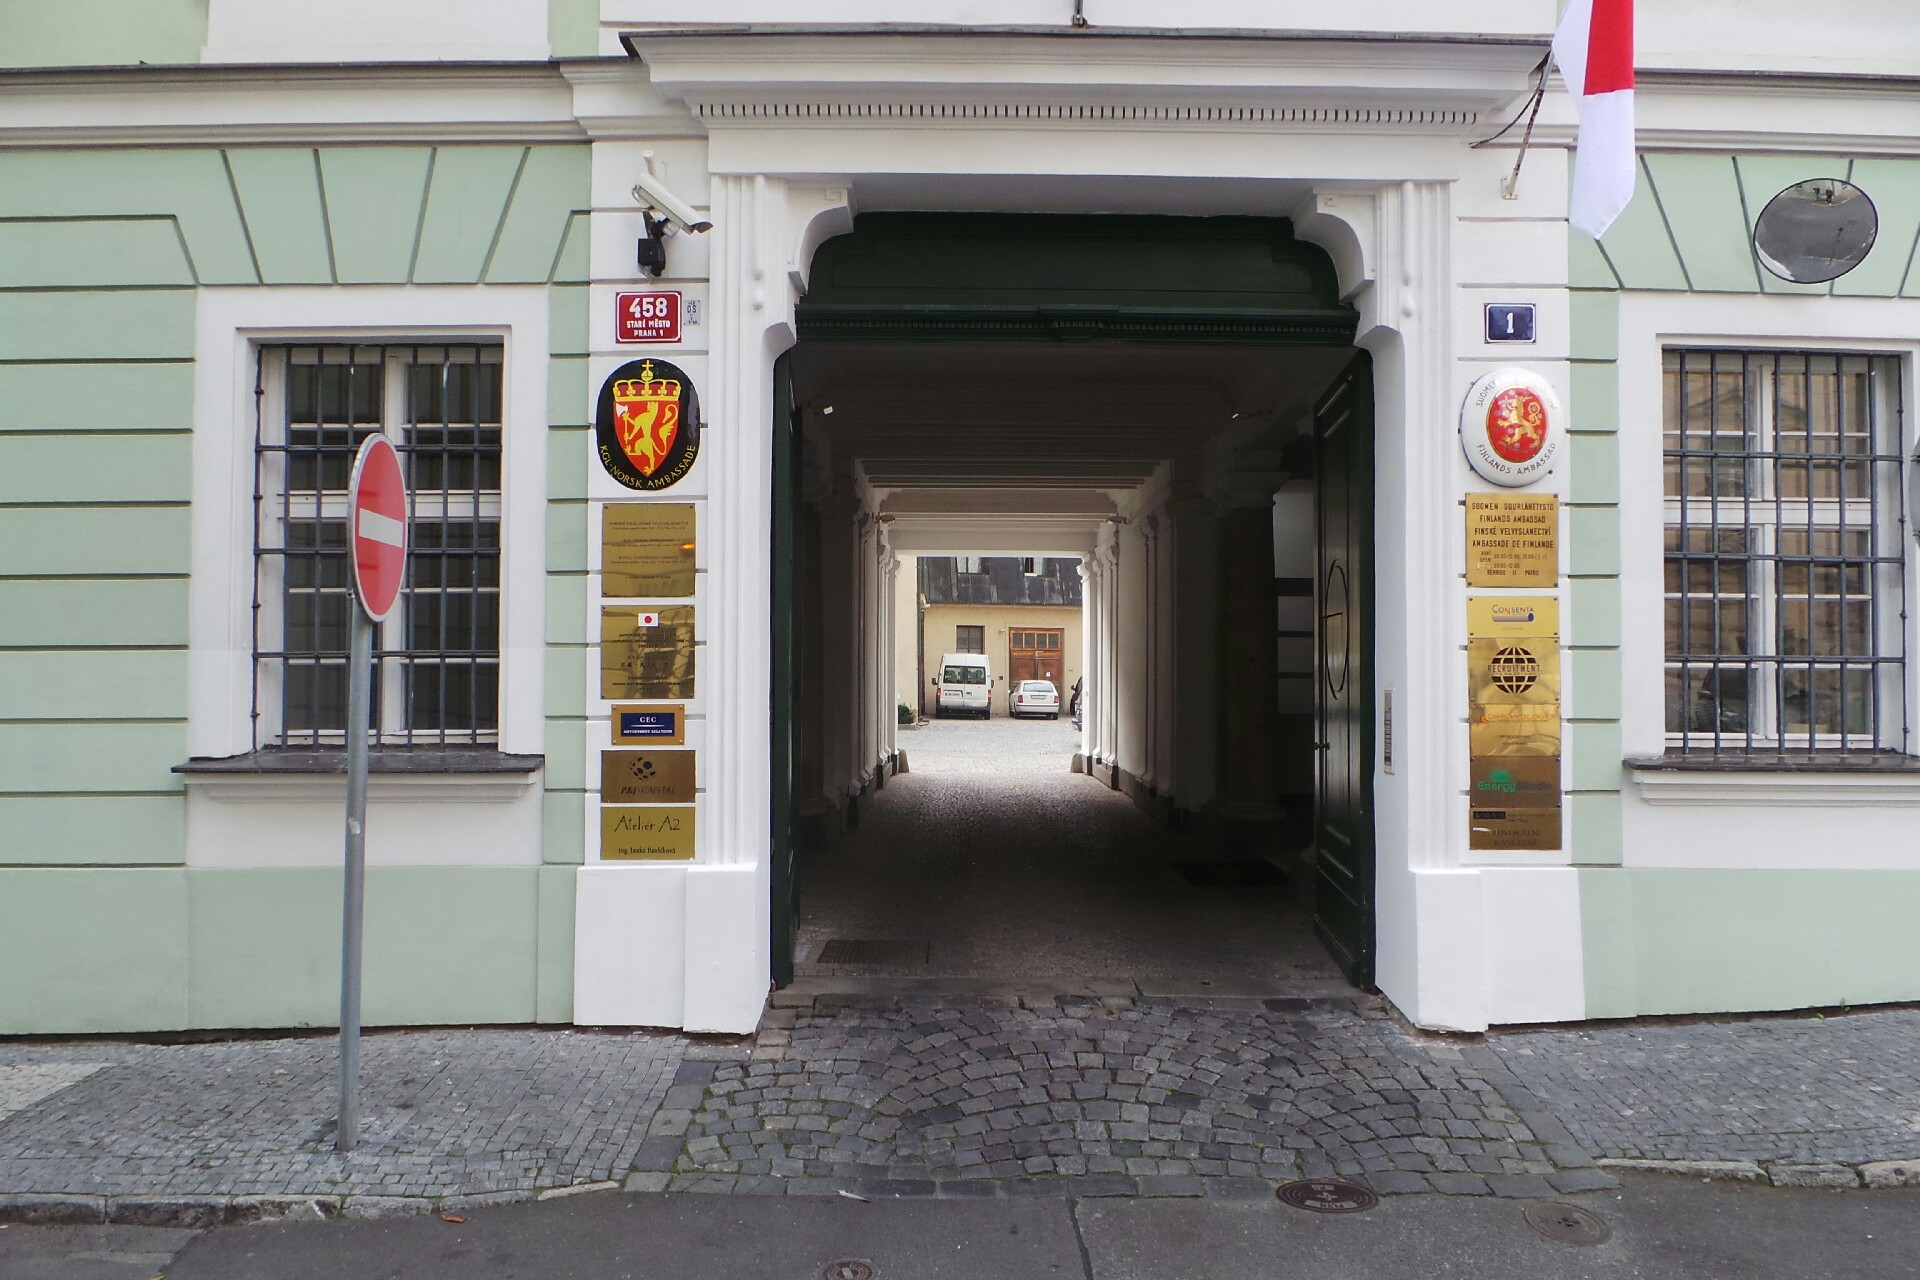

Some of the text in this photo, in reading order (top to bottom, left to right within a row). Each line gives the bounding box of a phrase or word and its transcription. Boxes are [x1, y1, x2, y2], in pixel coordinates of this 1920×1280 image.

[629, 298, 668, 318] 458
[648, 318, 671, 328] MĚSTO
[1506, 312, 1514, 334] 1
[633, 329, 664, 337] PRAHA 1
[1476, 442, 1556, 475] FINLANDS AMBASSAD
[610, 465, 643, 488] NORSK
[646, 444, 696, 489] AMBASSADE
[1471, 502, 1499, 511] SUOMEN
[1479, 515, 1546, 524] FINLANDS AMBASSAD
[1474, 526, 1551, 536] FINSKÉ VELVYSLANECTVÍ
[1472, 540, 1554, 549] AMBASSADE DE FINLANDE
[1487, 664, 1541, 673] RECRUITMENT
[658, 814, 681, 833] A2
